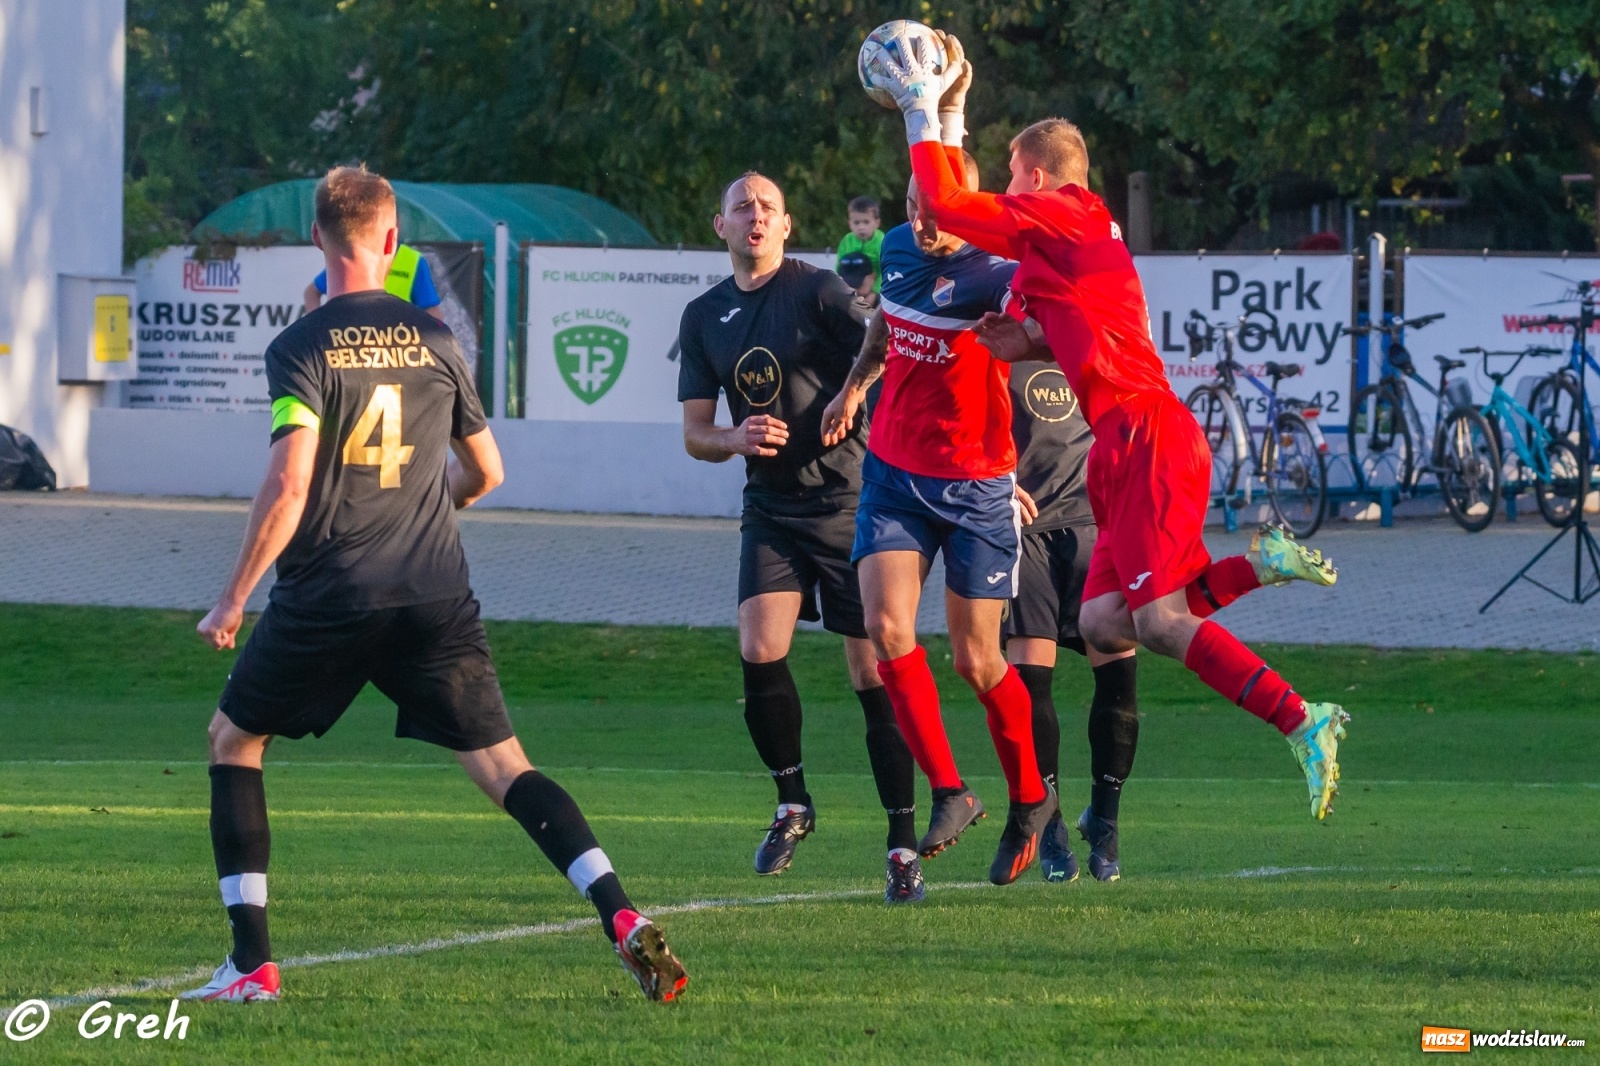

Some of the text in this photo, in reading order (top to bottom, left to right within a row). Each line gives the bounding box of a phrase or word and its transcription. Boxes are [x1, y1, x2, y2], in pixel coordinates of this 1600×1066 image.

[542, 270, 561, 282] FC
[618, 272, 700, 286] PARTNEREM
[1212, 266, 1323, 311] Park
[551, 310, 572, 328] FC
[139, 329, 236, 343] UDOWLANE
[328, 321, 421, 348] ROZWÓJ
[893, 327, 935, 349] SPORT
[323, 346, 437, 370] BEŁSZNICA
[740, 365, 775, 387] W&H
[1032, 387, 1072, 402] W&H
[342, 383, 415, 490] 4
